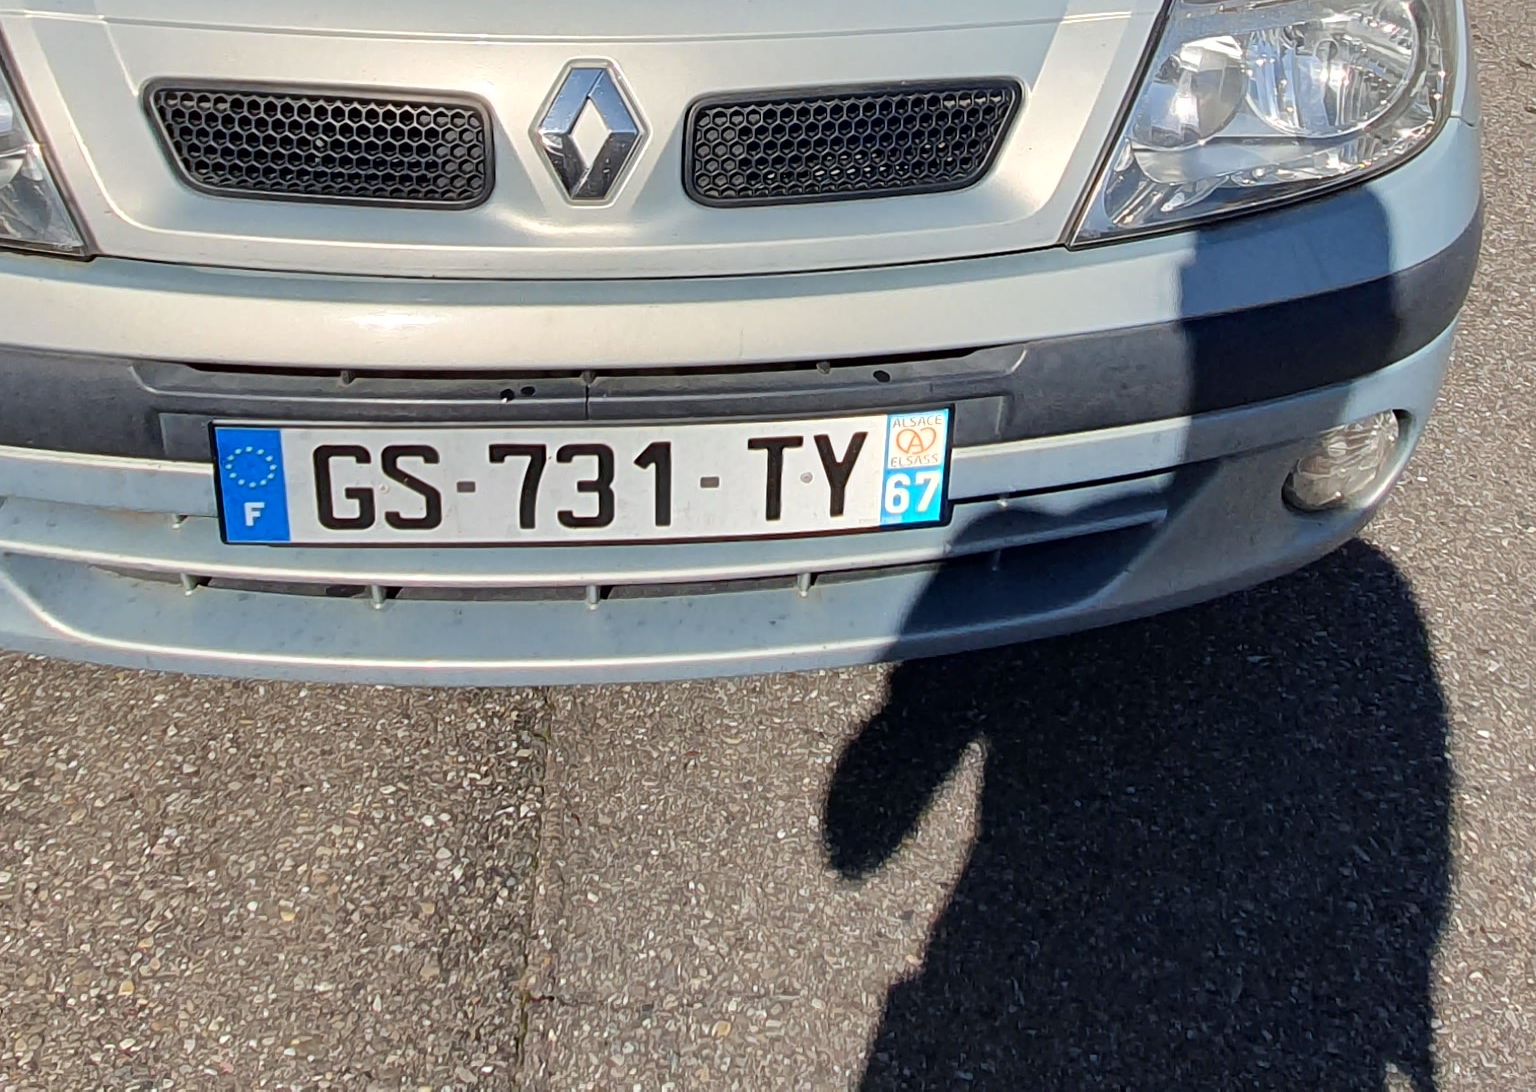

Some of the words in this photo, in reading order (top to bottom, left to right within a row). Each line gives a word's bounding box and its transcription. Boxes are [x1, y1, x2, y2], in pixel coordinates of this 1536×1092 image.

[893, 414, 942, 428] ALSACE
[890, 453, 939, 468] ELSASS
[884, 471, 941, 514] 67
[244, 502, 265, 527] F
